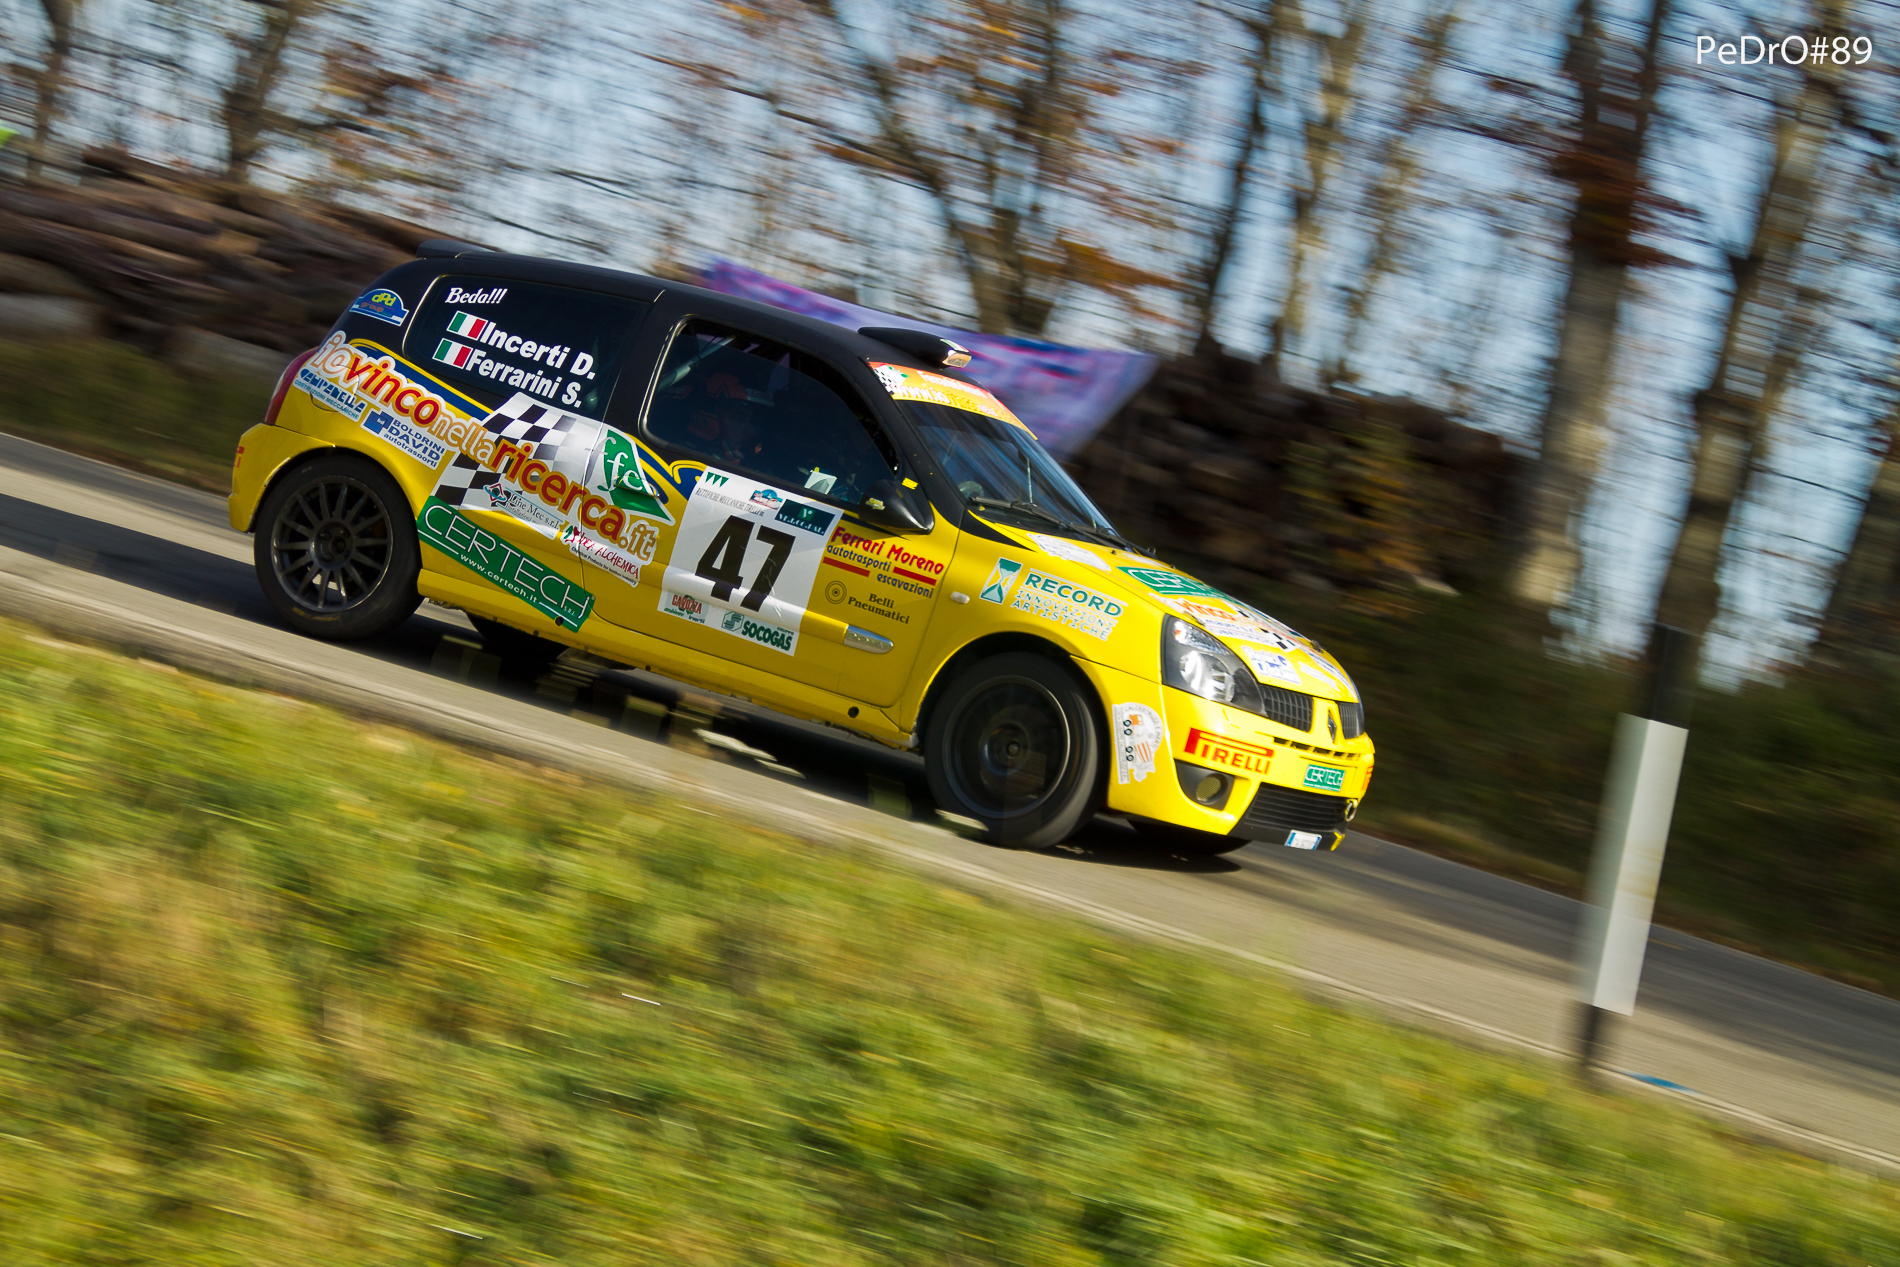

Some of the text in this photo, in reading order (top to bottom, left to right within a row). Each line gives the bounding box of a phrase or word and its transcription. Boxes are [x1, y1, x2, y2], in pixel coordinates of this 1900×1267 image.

[445, 287, 507, 305] Beda!!!
[479, 320, 596, 380] Incerti D.
[466, 349, 583, 408] Ferrarini S.
[384, 433, 437, 467] autotrasporti
[388, 426, 441, 461] DAVID
[393, 420, 446, 454] BOLDRINI
[526, 504, 546, 520] Mec
[543, 515, 561, 529] s.r.l.
[424, 504, 589, 619] CERTECH
[594, 540, 639, 580] ALCHEMICA
[694, 515, 796, 613] 47
[827, 544, 891, 573] autotrasporti
[832, 526, 945, 576] Ferrari Moreno
[460, 553, 537, 603] www.certech.it
[877, 572, 934, 599] escavazioni
[1025, 573, 1122, 616] RECORD
[672, 594, 702, 615] CAVOZZA
[848, 596, 910, 625] Pneumatici
[868, 593, 895, 610] Belli
[1016, 590, 1115, 631] INNOVAZIONI
[741, 619, 793, 652] SOCOGAS
[776, 626, 795, 636] GRUPPO
[1011, 600, 1109, 640] ARTISTICHE
[1184, 727, 1275, 775] PIRELLI
[1304, 764, 1345, 787] CERTECH
